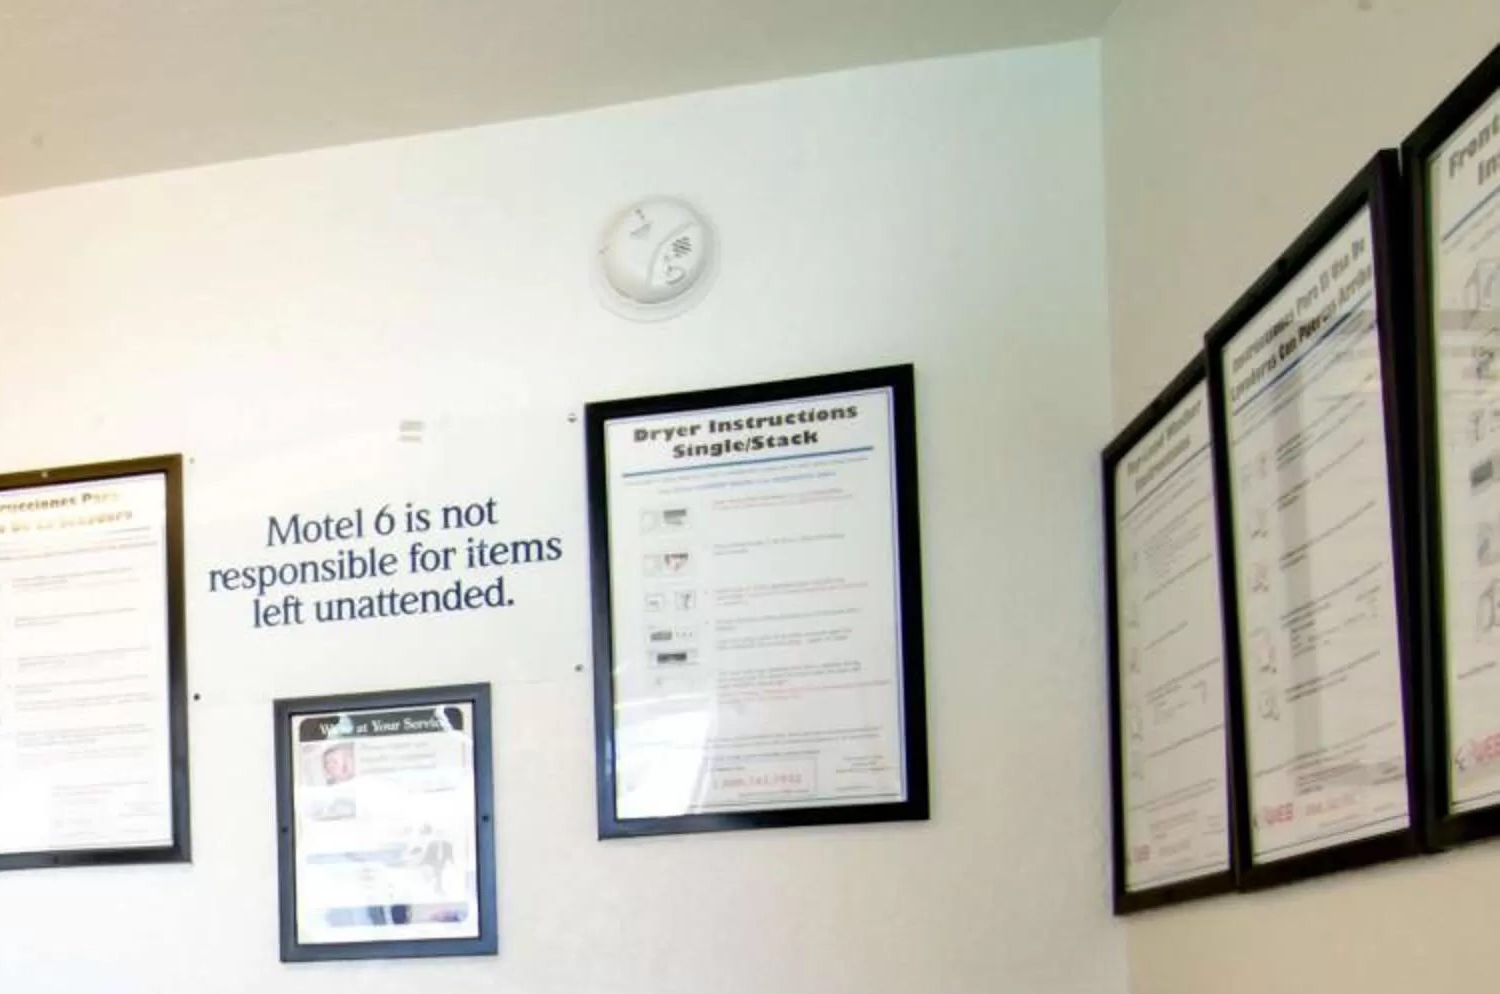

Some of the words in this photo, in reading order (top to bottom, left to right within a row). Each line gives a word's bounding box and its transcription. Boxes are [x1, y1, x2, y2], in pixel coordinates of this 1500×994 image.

[633, 421, 701, 443] Dryer
[708, 404, 859, 434] Instructions
[672, 429, 819, 460] Single/Stack
[265, 508, 363, 548] Motel
[374, 504, 396, 537] 6
[405, 502, 431, 534] is
[442, 497, 500, 531] not
[208, 549, 399, 597] responsible
[410, 542, 457, 574] for
[466, 535, 564, 570] items
[252, 595, 304, 628] left
[314, 576, 516, 623] unattended.
[371, 719, 401, 733] Your
